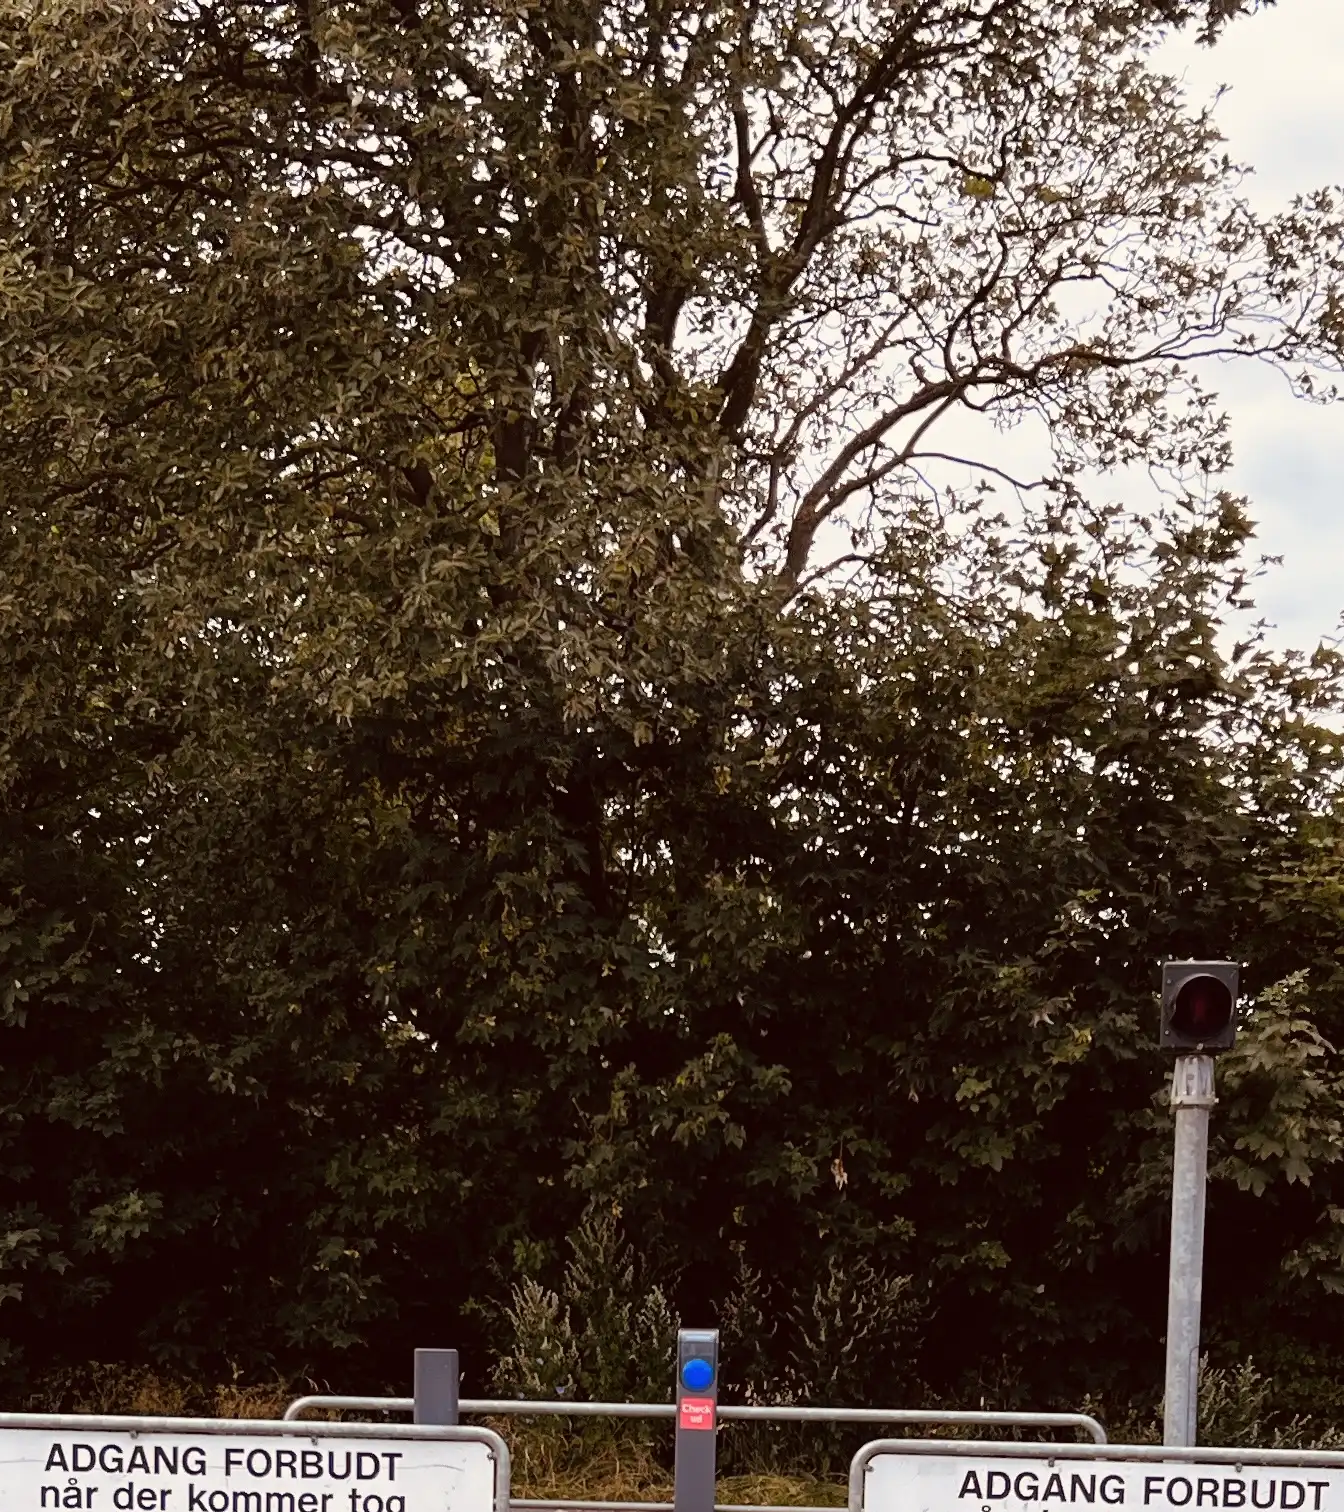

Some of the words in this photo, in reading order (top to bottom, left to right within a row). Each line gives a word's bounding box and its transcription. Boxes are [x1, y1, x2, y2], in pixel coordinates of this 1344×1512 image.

[681, 1403, 711, 1414] Check
[44, 1443, 207, 1476] ADGANG
[224, 1447, 403, 1482] FORBUDT
[40, 1477, 99, 1510] når
[113, 1481, 173, 1512] der
[957, 1470, 1125, 1505] ADGANG
[1143, 1476, 1330, 1511] FORBUDT
